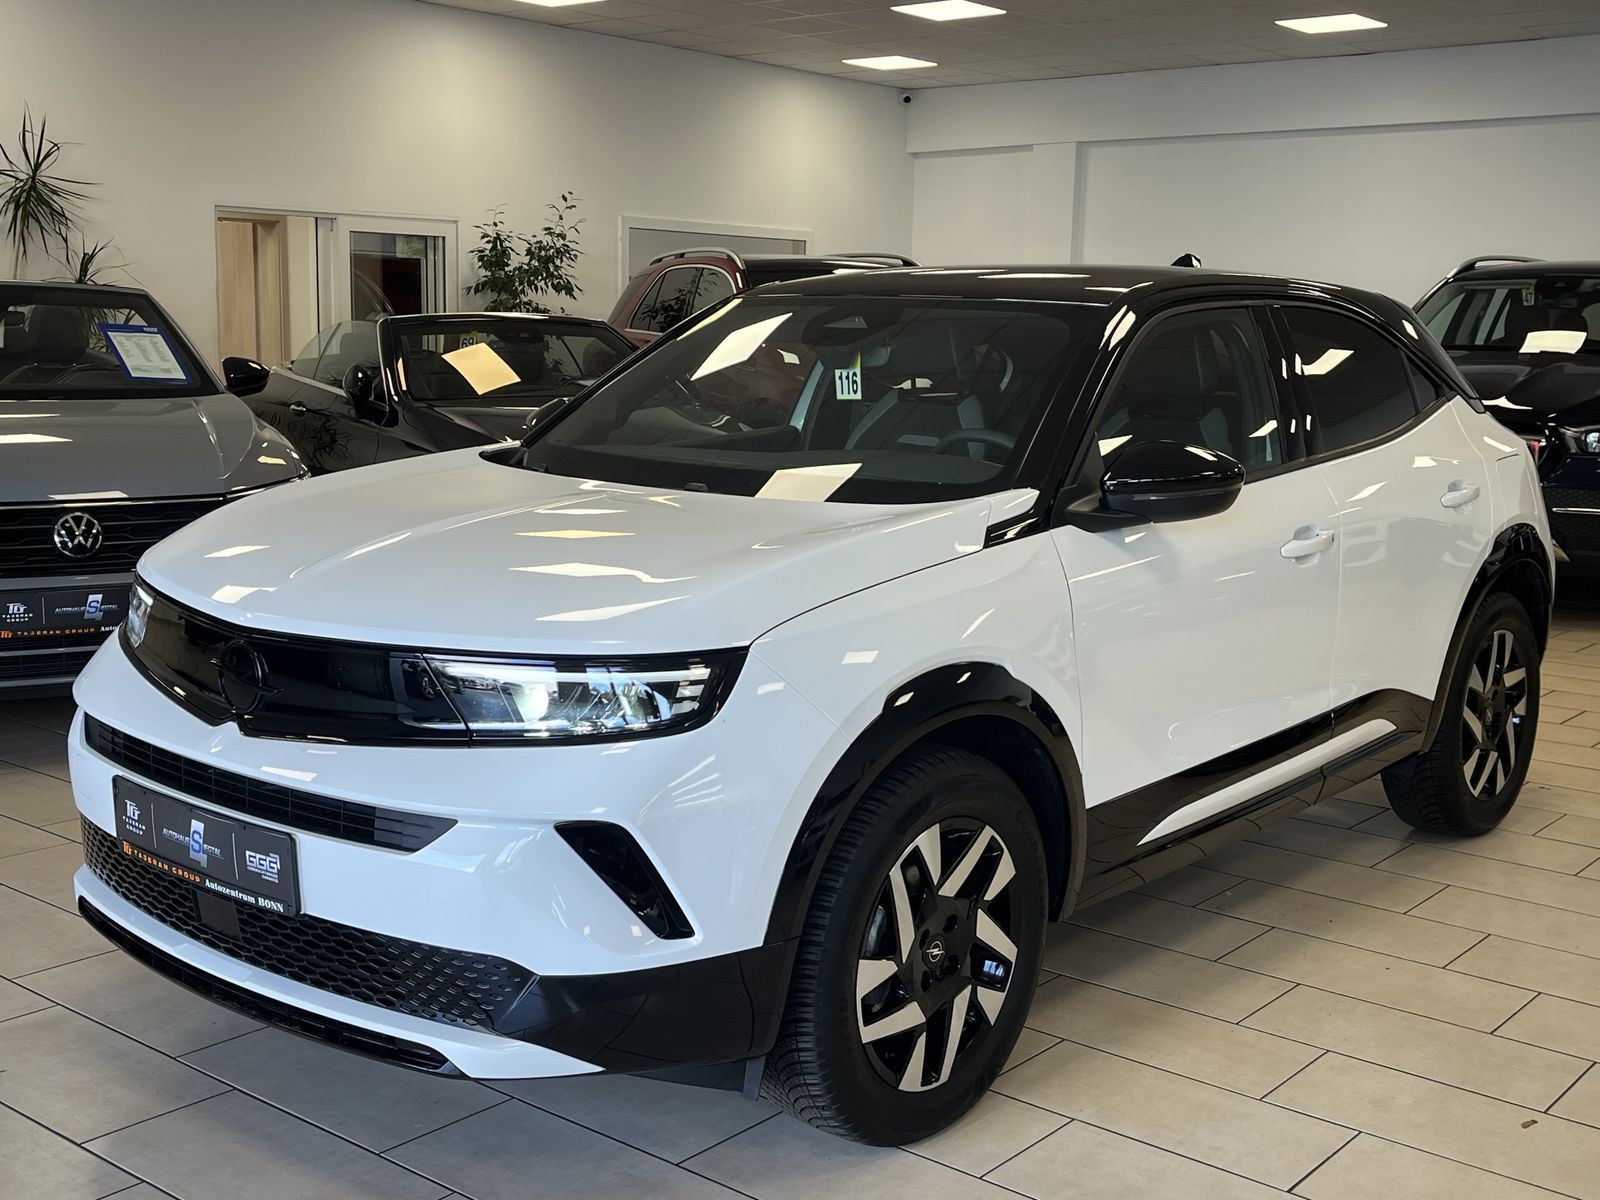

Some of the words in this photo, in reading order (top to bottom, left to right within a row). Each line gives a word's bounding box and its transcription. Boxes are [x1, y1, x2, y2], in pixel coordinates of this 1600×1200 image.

[838, 371, 859, 395] 116
[205, 879, 255, 904] Autozentrum
[258, 897, 284, 912] BONN
